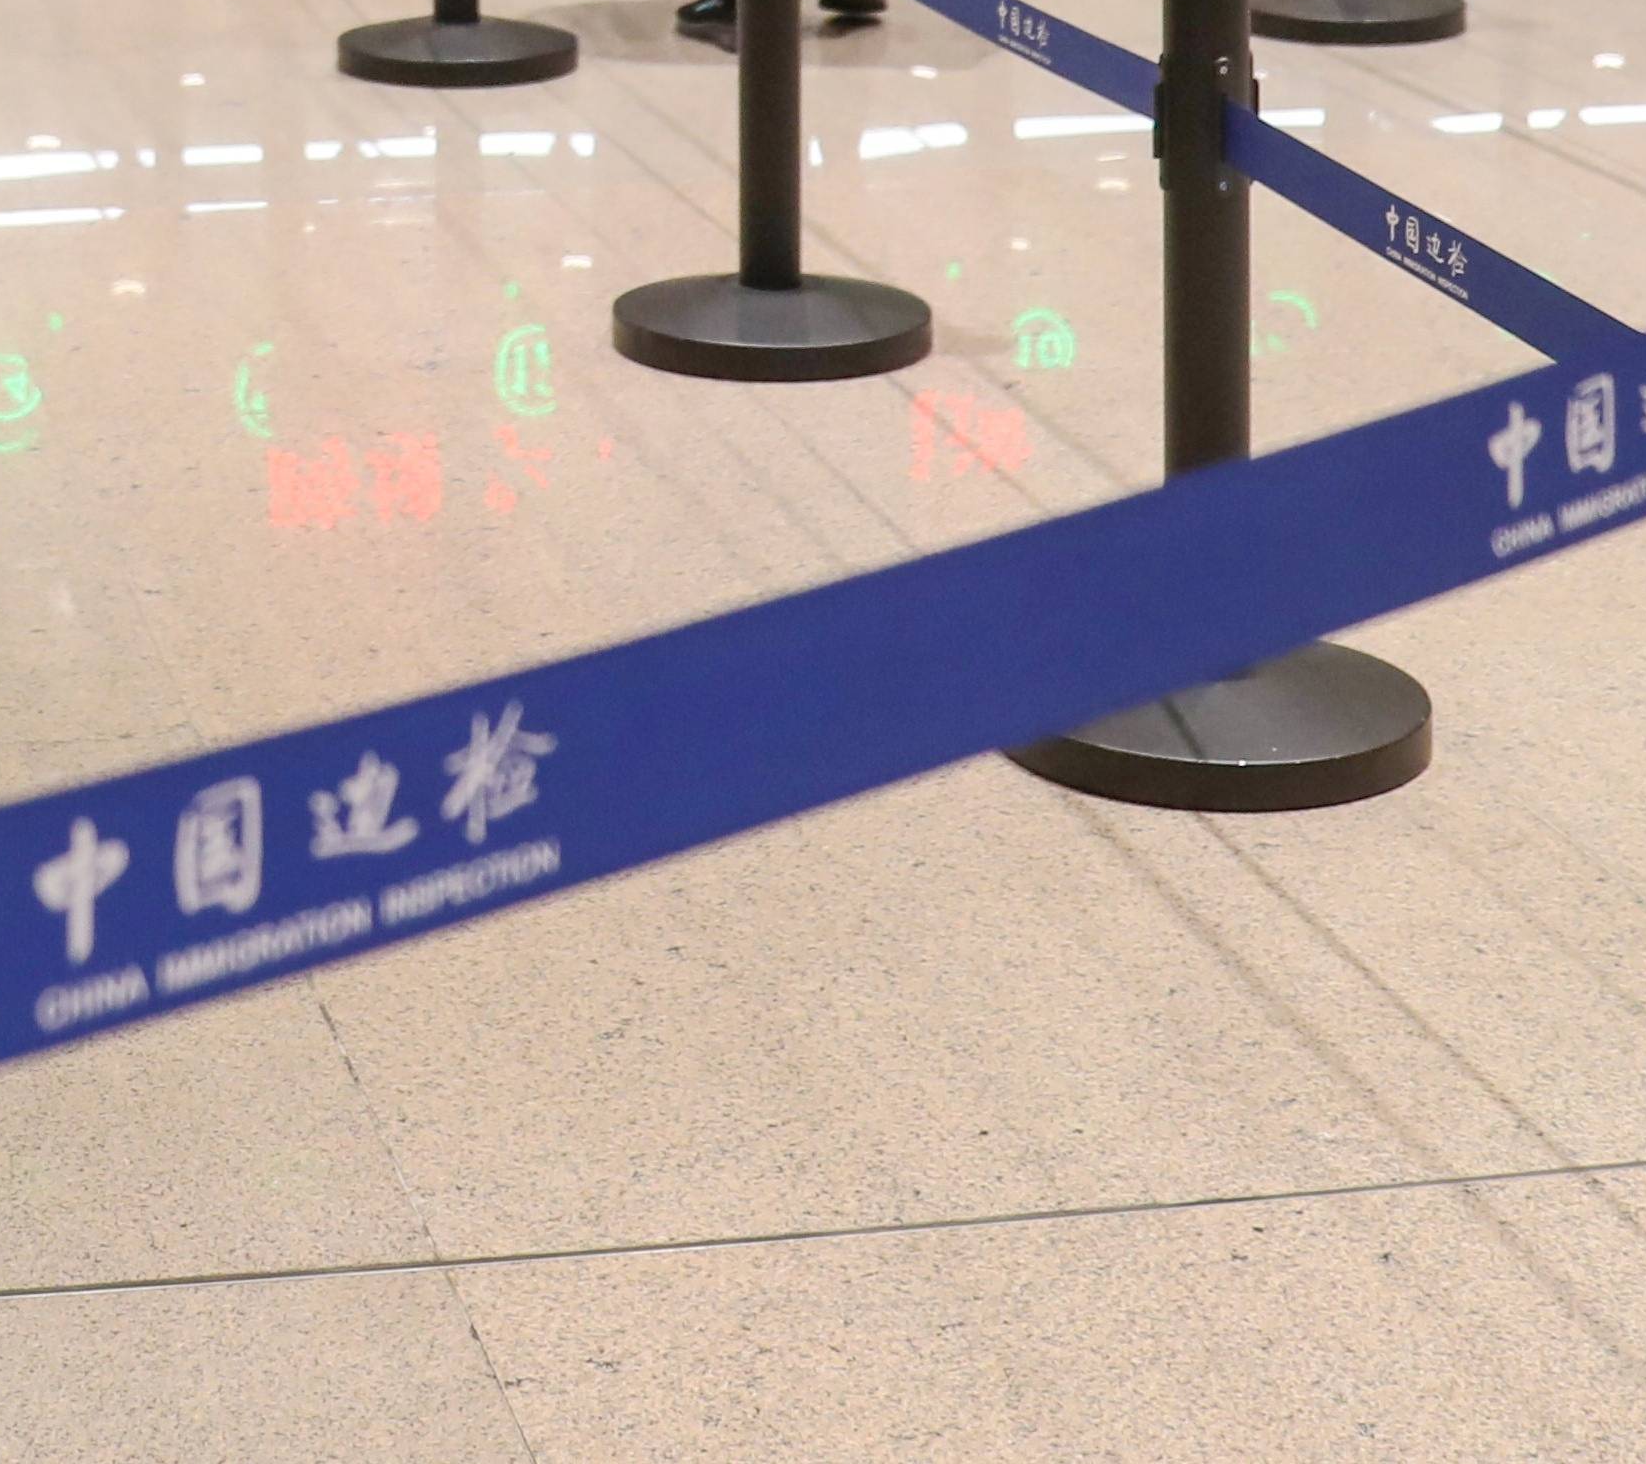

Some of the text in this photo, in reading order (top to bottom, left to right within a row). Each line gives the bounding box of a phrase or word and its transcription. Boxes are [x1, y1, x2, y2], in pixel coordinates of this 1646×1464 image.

[1386, 203, 1468, 278] 中国边检
[31, 699, 557, 966] 中国边检
